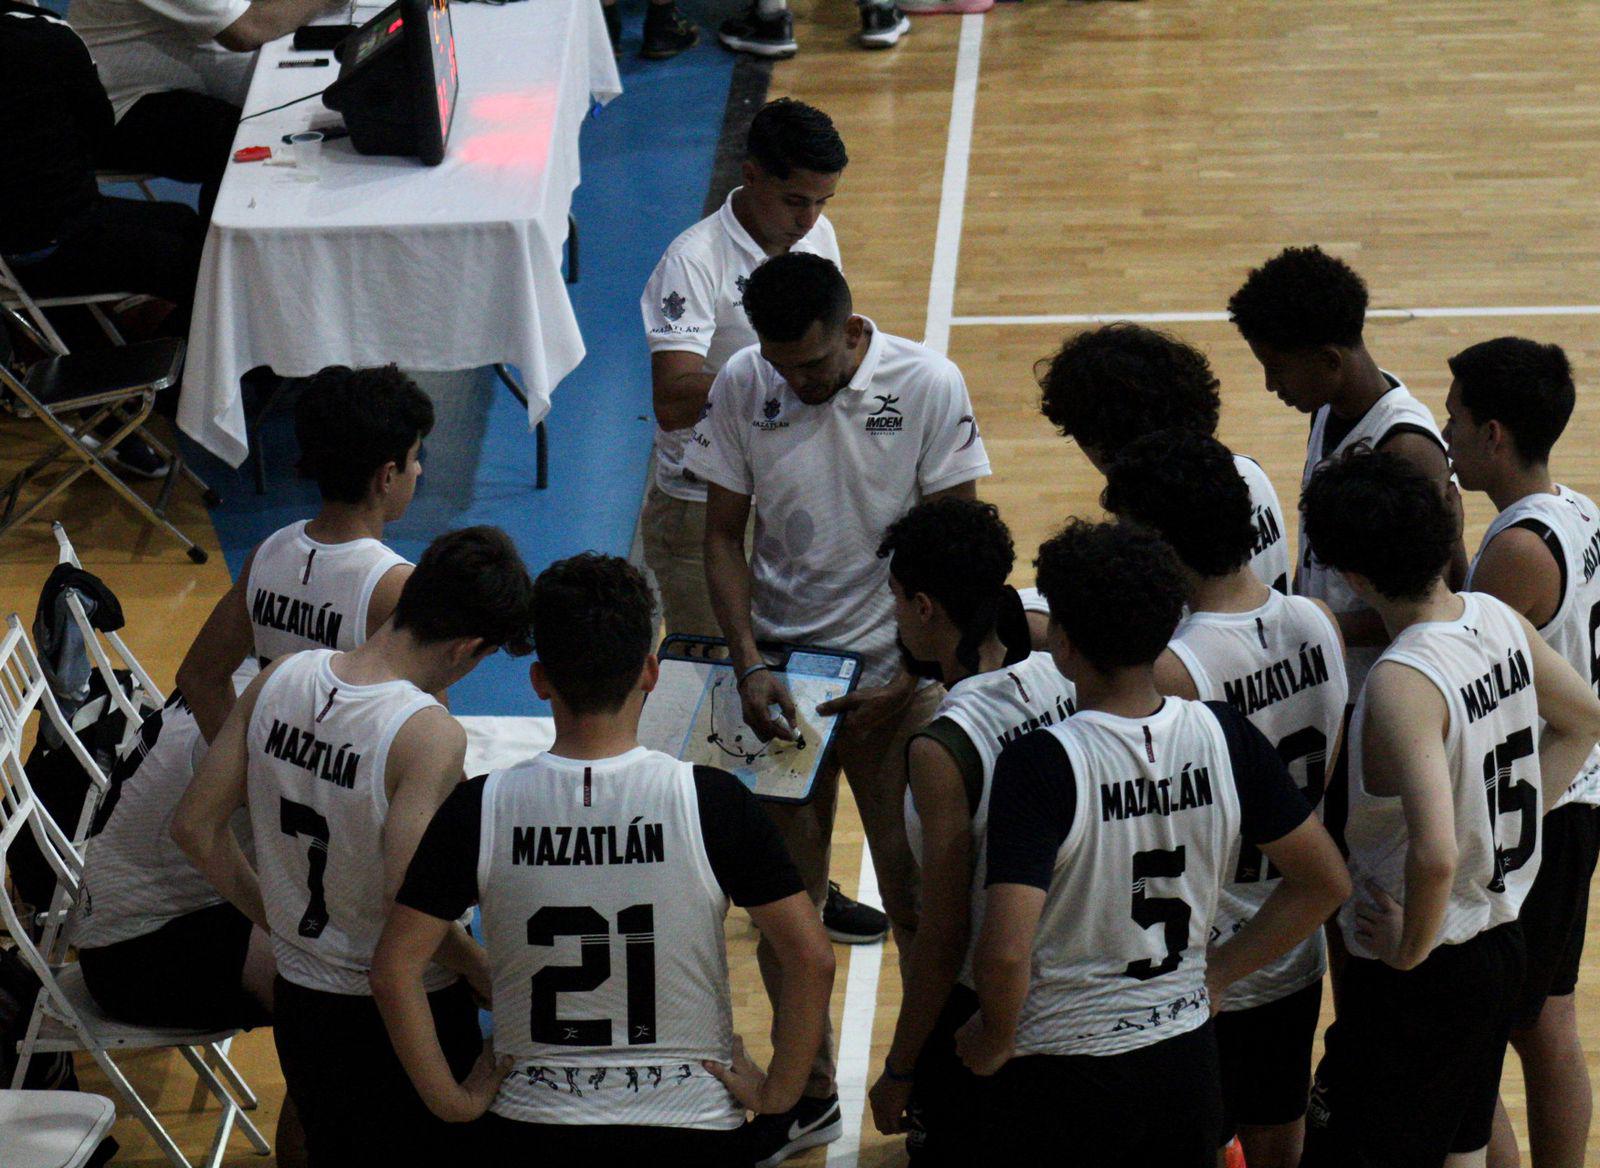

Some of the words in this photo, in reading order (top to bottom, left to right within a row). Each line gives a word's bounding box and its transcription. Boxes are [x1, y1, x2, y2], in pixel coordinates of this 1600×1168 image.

[865, 416, 903, 428] IMDEM
[252, 588, 343, 649] MAZATLÁN
[1223, 641, 1330, 717] MAZATLÁN
[1460, 647, 1531, 724] MAZLÁN
[280, 796, 330, 939] 7
[512, 816, 665, 866] MAZATLÁN
[1124, 845, 1192, 981] 5
[527, 903, 657, 1047] 21
